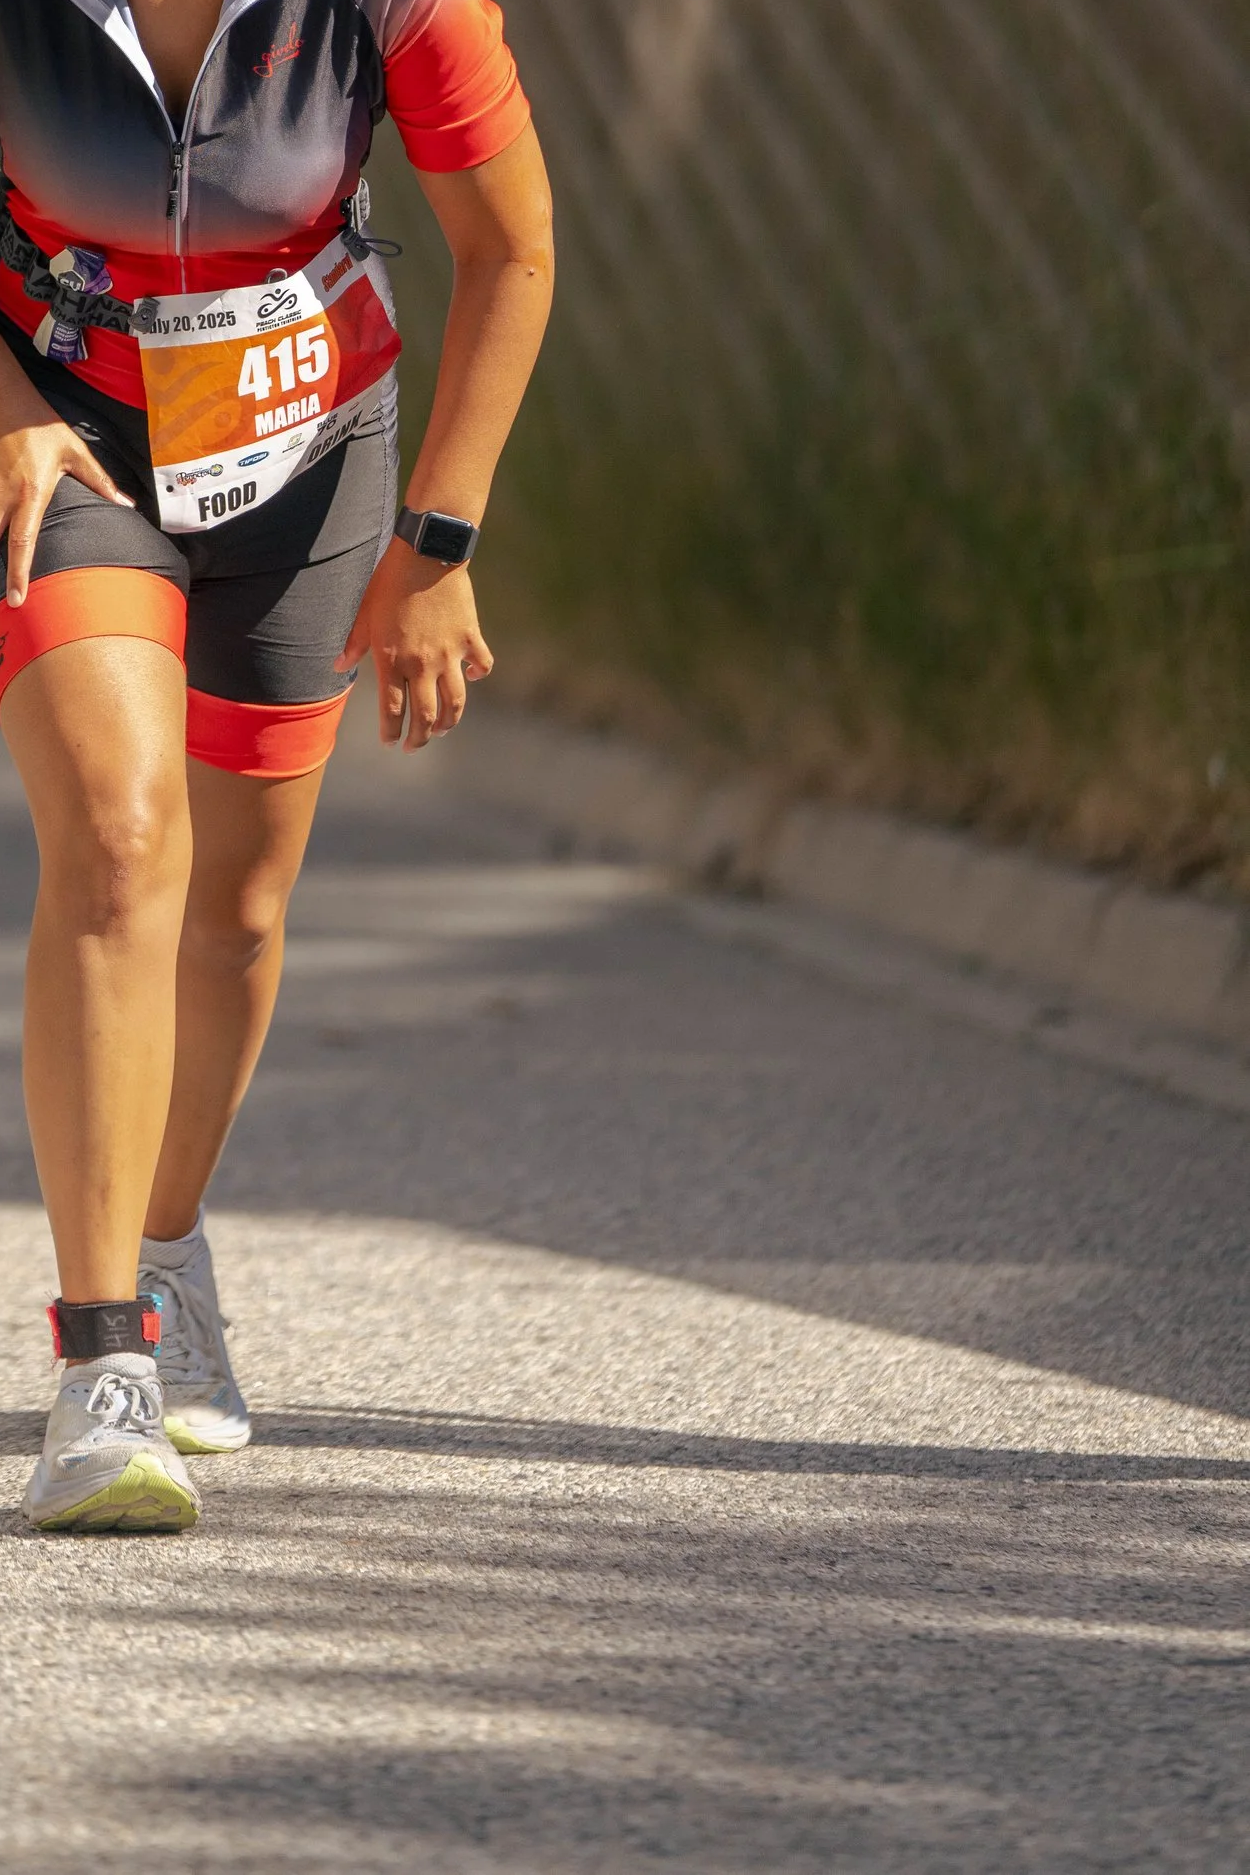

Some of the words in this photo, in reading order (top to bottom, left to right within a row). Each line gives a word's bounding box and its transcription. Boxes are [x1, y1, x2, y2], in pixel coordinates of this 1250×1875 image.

[142, 318, 169, 334] uly
[173, 315, 194, 332] 20,
[197, 311, 236, 330] 2025
[256, 319, 276, 328] PEACH
[278, 309, 302, 321] CLASSIC
[238, 324, 329, 401] 415
[255, 393, 321, 437] MARIA
[307, 409, 363, 464] DRINK
[239, 452, 268, 466] TIFOSI
[198, 481, 257, 522] FOOD
[101, 1312, 129, 1348] 415
